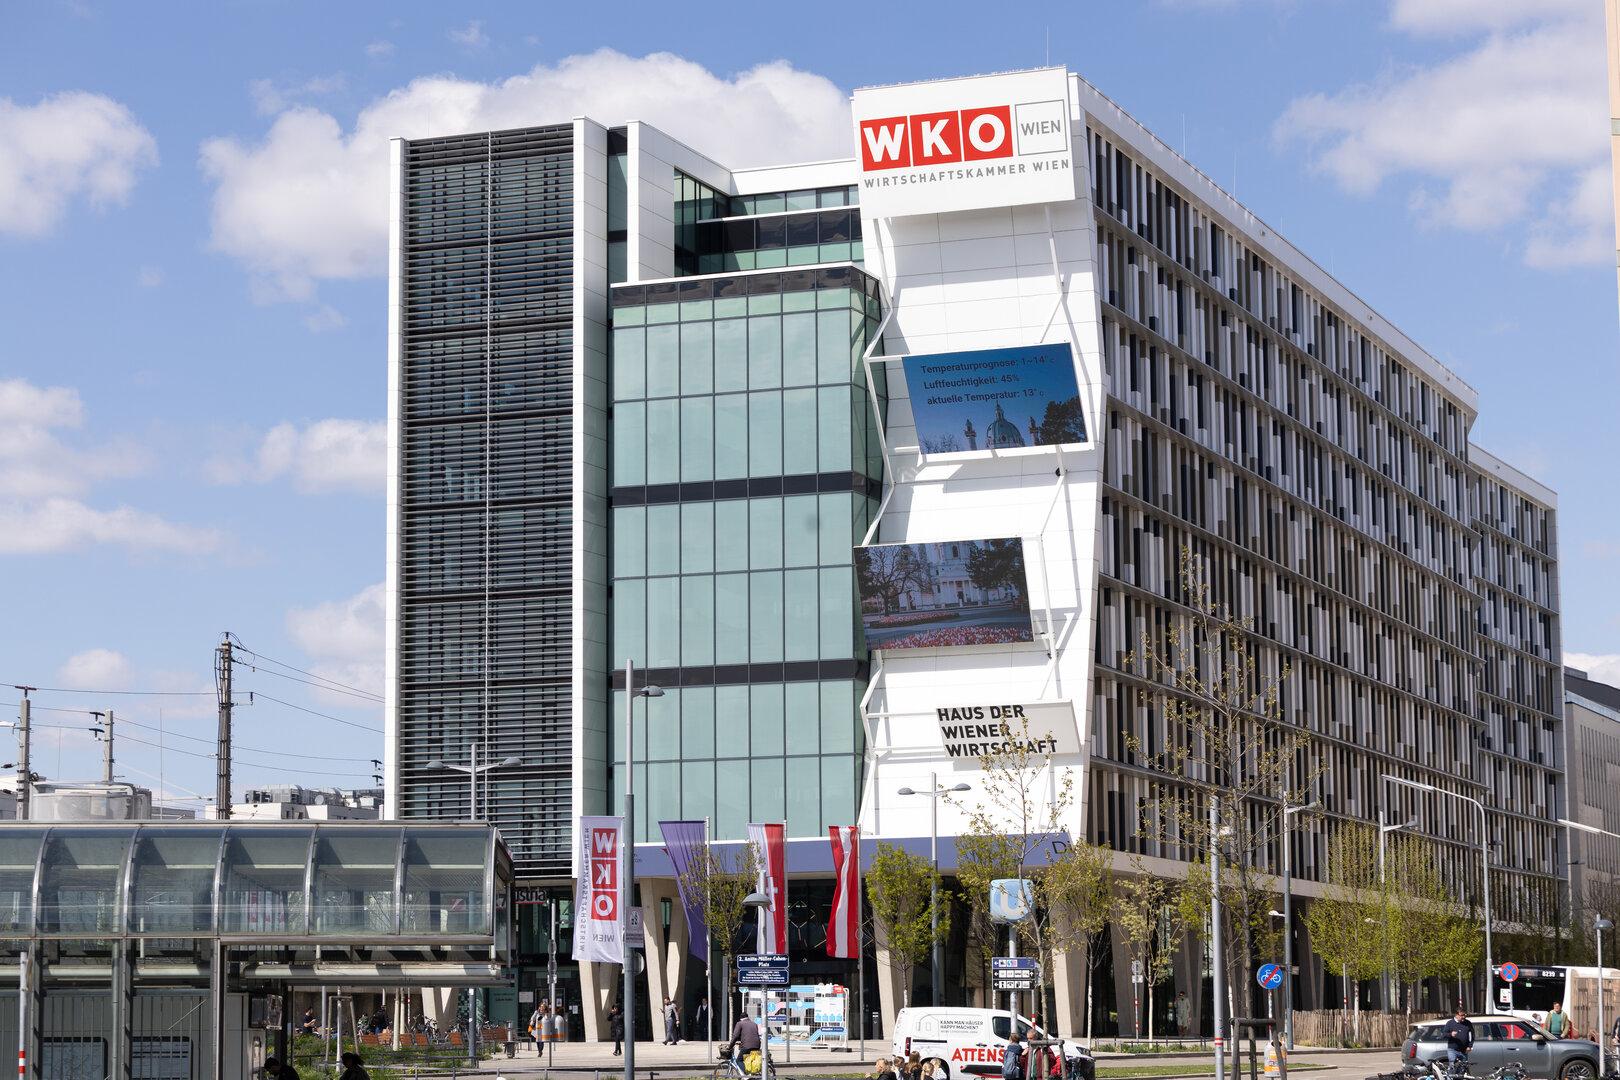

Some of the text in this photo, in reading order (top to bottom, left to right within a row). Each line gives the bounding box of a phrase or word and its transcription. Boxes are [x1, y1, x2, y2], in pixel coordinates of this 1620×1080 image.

[863, 114, 1061, 163] WKO WIEN
[864, 159, 1069, 188] WIRTSCHAFTSKAMMER WIEN
[921, 358, 1019, 374] Temperaturprognose:
[923, 374, 1020, 390] Luftfeuchtigkeit: 45%
[927, 394, 963, 405] aktuelle
[964, 390, 1020, 403] Temperatur:
[937, 704, 1025, 721] HAUS DER
[941, 723, 1011, 739] WIENER
